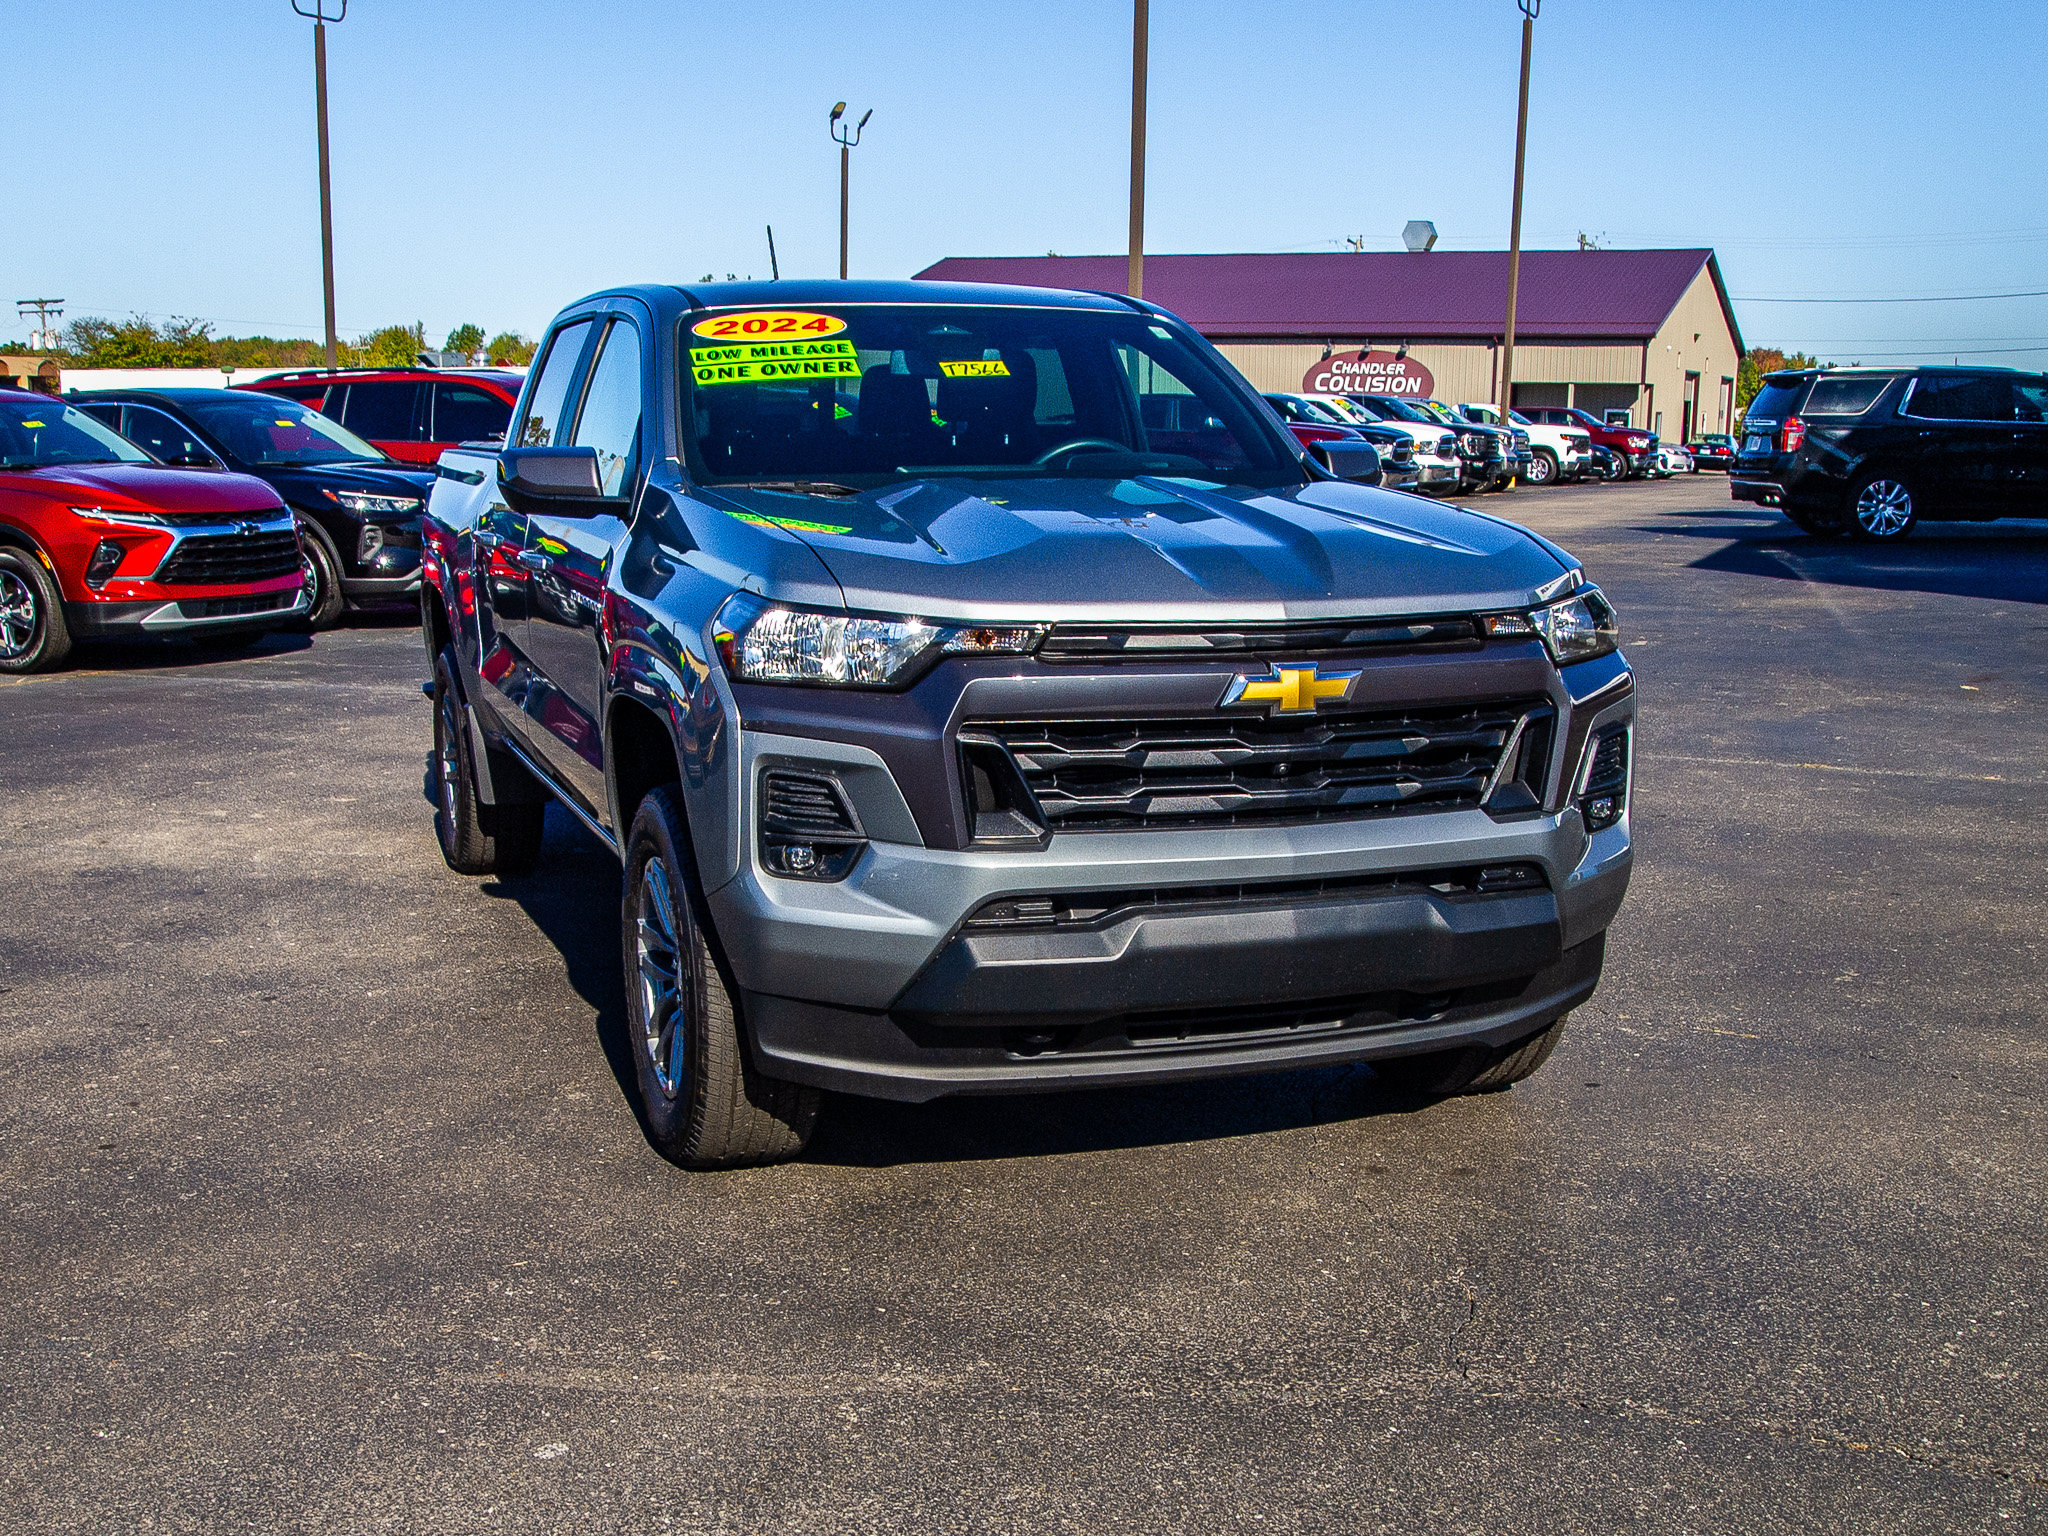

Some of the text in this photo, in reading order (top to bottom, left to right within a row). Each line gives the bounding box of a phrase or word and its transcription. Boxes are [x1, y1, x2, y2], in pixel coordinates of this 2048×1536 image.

[711, 317, 830, 336] 2024
[695, 343, 850, 362] LOW MILEAGE
[697, 361, 855, 380] ONE OWNER
[1331, 360, 1406, 375] CHANDLER
[1314, 372, 1422, 393] COLLISION
